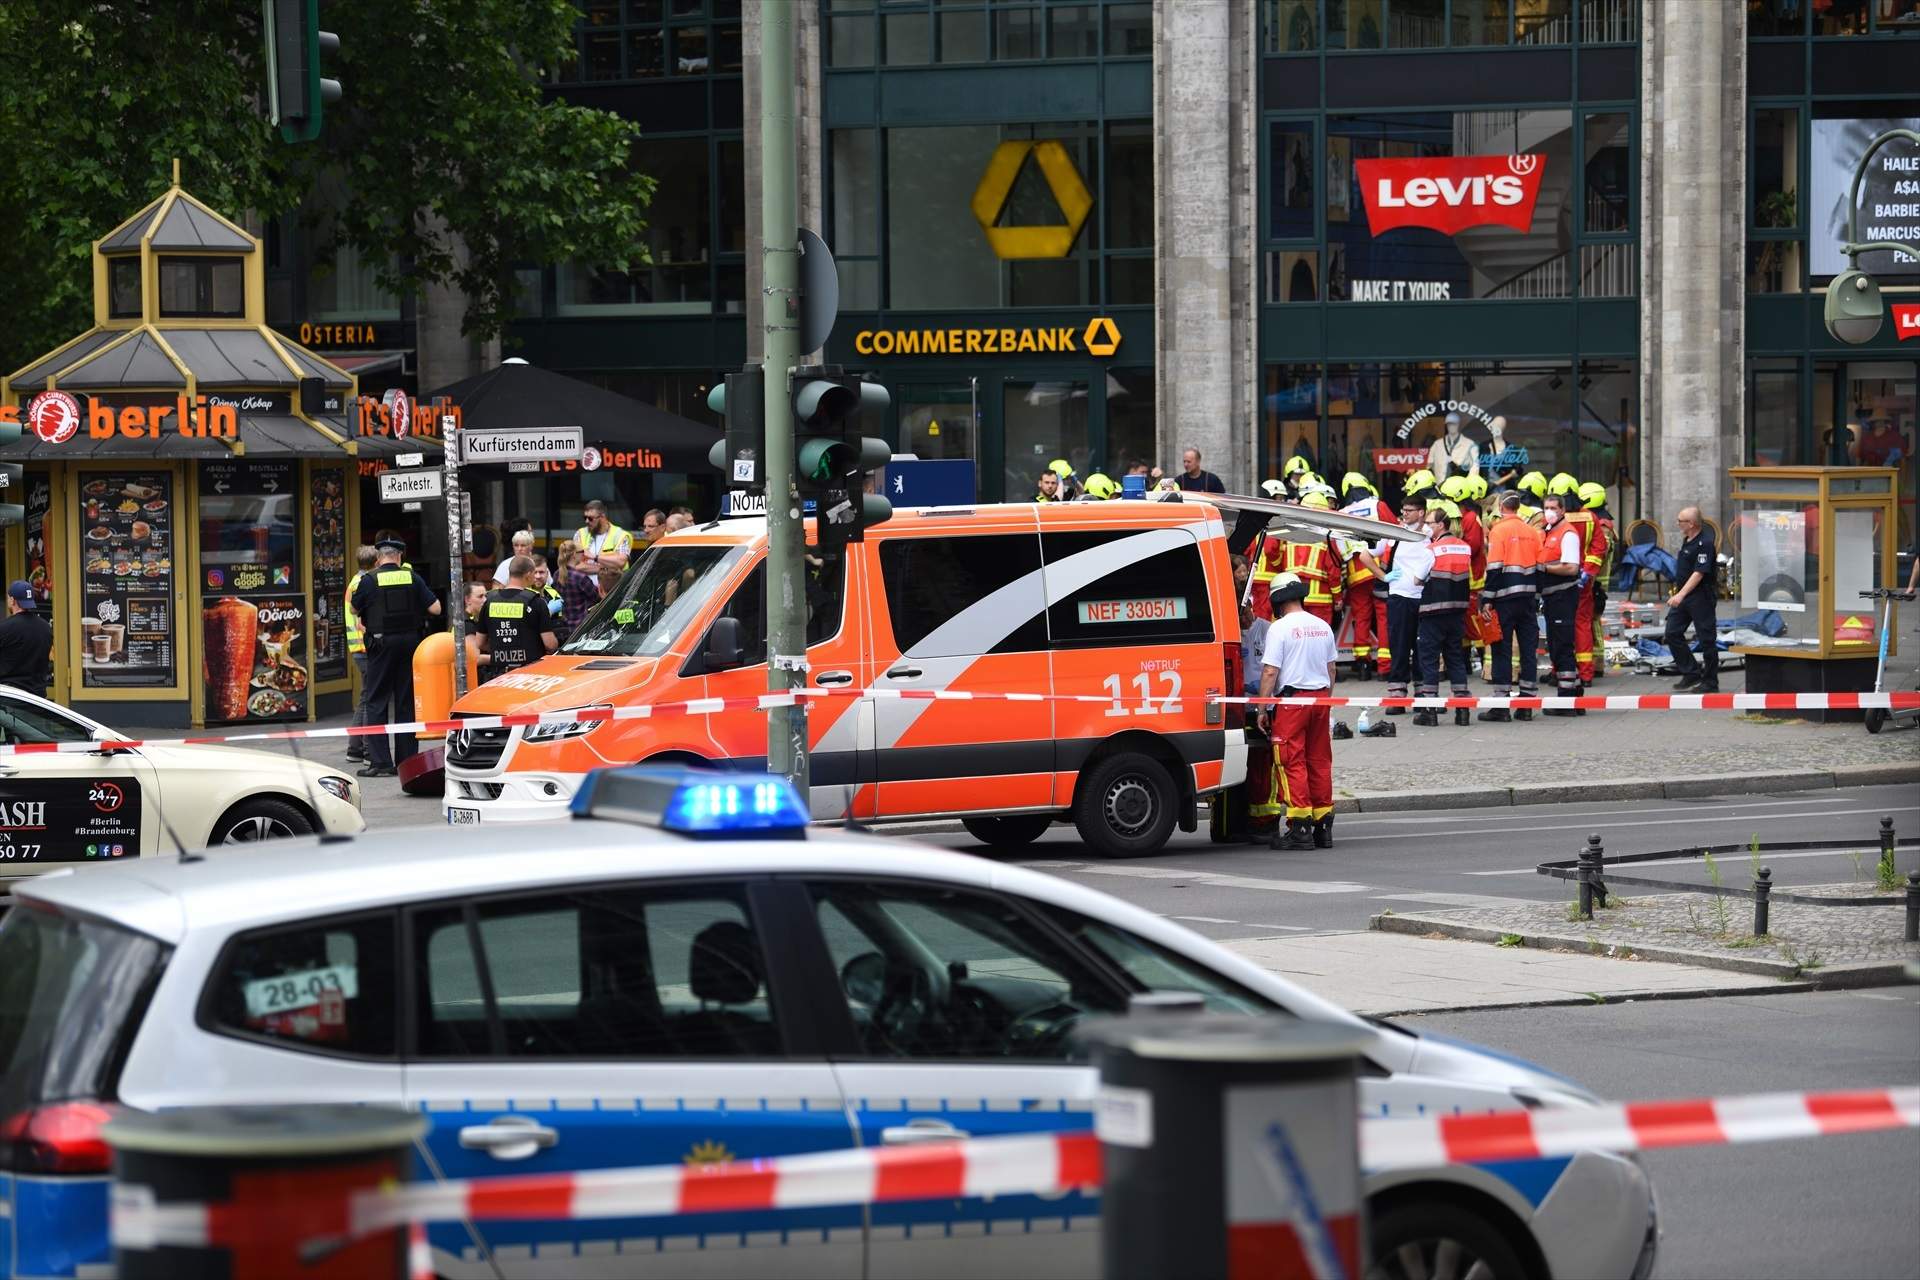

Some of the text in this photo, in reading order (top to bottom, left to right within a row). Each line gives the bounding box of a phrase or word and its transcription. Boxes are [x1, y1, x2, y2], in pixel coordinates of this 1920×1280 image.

[1883, 157, 1920, 171] HAILE
[1894, 180, 1920, 195] A$A
[1867, 227, 1920, 240] MARCUS
[1352, 280, 1450, 301] MAKE IT YOURS
[300, 322, 375, 344] OSTERIA
[855, 328, 1076, 355] COMMERZBANK
[241, 396, 273, 411] Kebap
[89, 396, 238, 440] berlin
[357, 396, 391, 438] it's
[411, 396, 463, 437] berlin
[1396, 400, 1502, 440] RIDING TOGETHER
[469, 436, 576, 453] Kurfürstendamm
[602, 449, 662, 469] berlin
[391, 476, 433, 492] Rankestr.
[732, 497, 766, 512] NOTA
[234, 578, 266, 588] Google
[258, 608, 302, 624] Döner
[490, 604, 523, 617] POLIZEI
[1087, 600, 1176, 621] NEF 3305/1
[500, 621, 511, 629] BE
[496, 629, 518, 637] 32320
[494, 650, 527, 662] POLIZEI
[1140, 659, 1181, 671] NOTRUF
[1103, 671, 1183, 717] 112
[90, 818, 121, 826] #Berlin
[75, 828, 136, 836] #Brandenburg
[21, 845, 41, 858] 77
